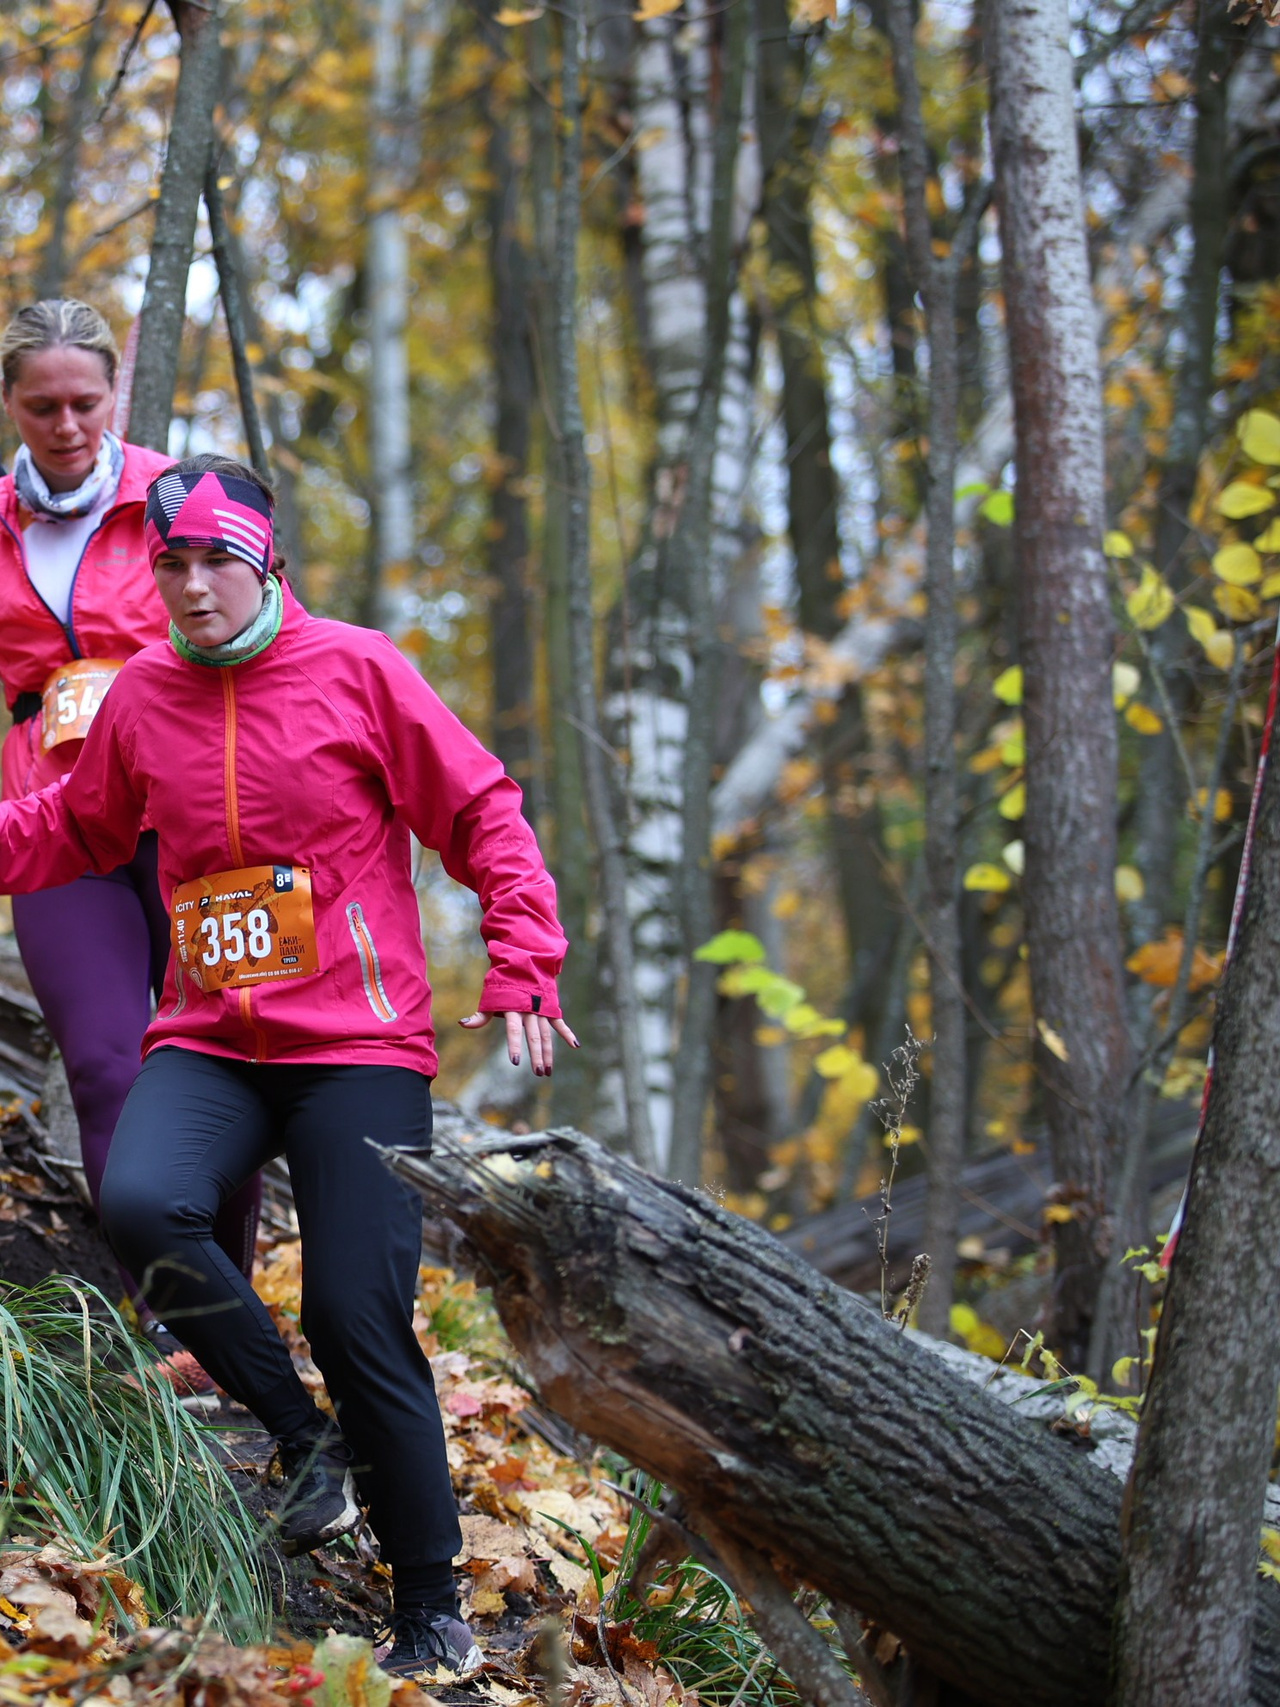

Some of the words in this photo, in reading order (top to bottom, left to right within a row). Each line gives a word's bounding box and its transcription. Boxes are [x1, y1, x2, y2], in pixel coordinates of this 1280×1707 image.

[57, 683, 111, 725] 54
[276, 873, 285, 887] 8
[175, 900, 195, 914] ICITY
[215, 890, 253, 902] HAVAL
[176, 919, 186, 946] 11:40
[200, 908, 272, 967] 358
